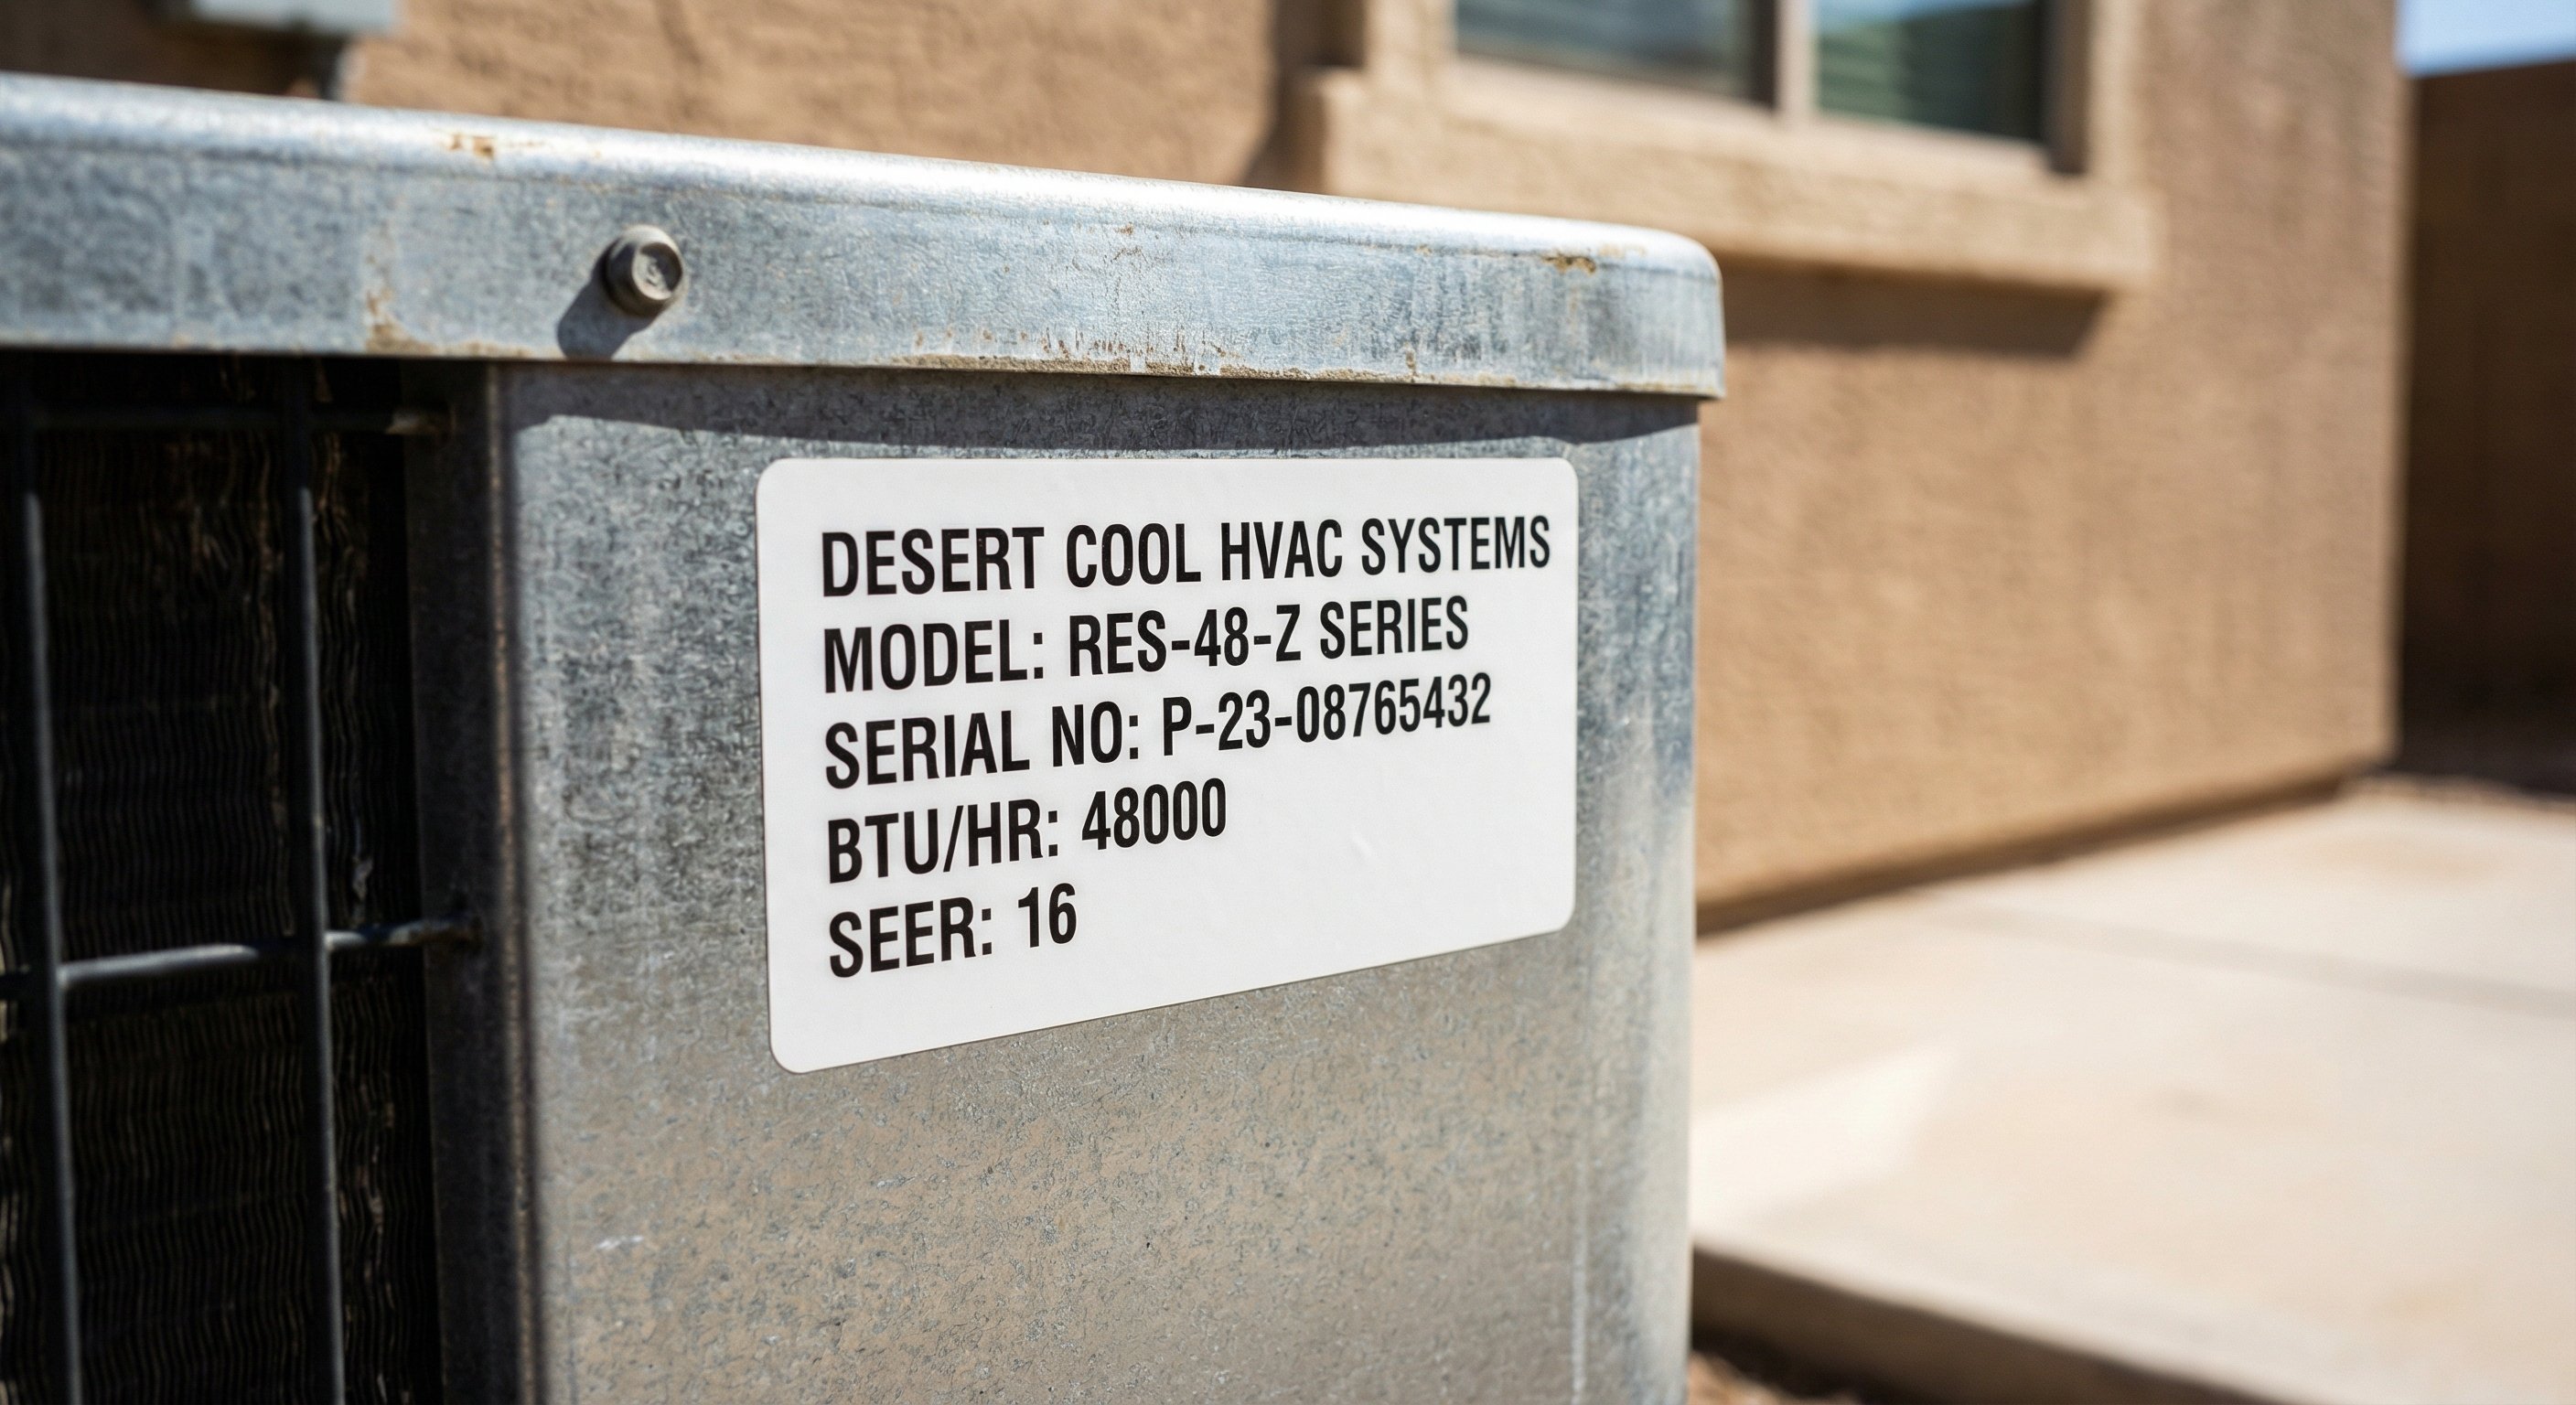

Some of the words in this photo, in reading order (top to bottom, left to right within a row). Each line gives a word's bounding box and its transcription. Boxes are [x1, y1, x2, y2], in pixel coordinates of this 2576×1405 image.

[821, 527, 1045, 597] DESERT
[1067, 521, 1202, 588] COOL
[1221, 519, 1343, 581] HVAC
[1361, 515, 1551, 576] SYSTEMS
[824, 618, 1046, 693] MODEL:
[1069, 604, 1302, 677] RES-48-Z
[1320, 595, 1469, 660] SERIES
[825, 710, 1030, 789] SERIAL
[1052, 701, 1140, 767] NO:
[1163, 672, 1492, 756] P-23-08765432
[828, 799, 1059, 885] BTU/HR:
[1081, 778, 1227, 851] 48000
[829, 896, 993, 978] SEER:
[1017, 883, 1078, 949] 16
